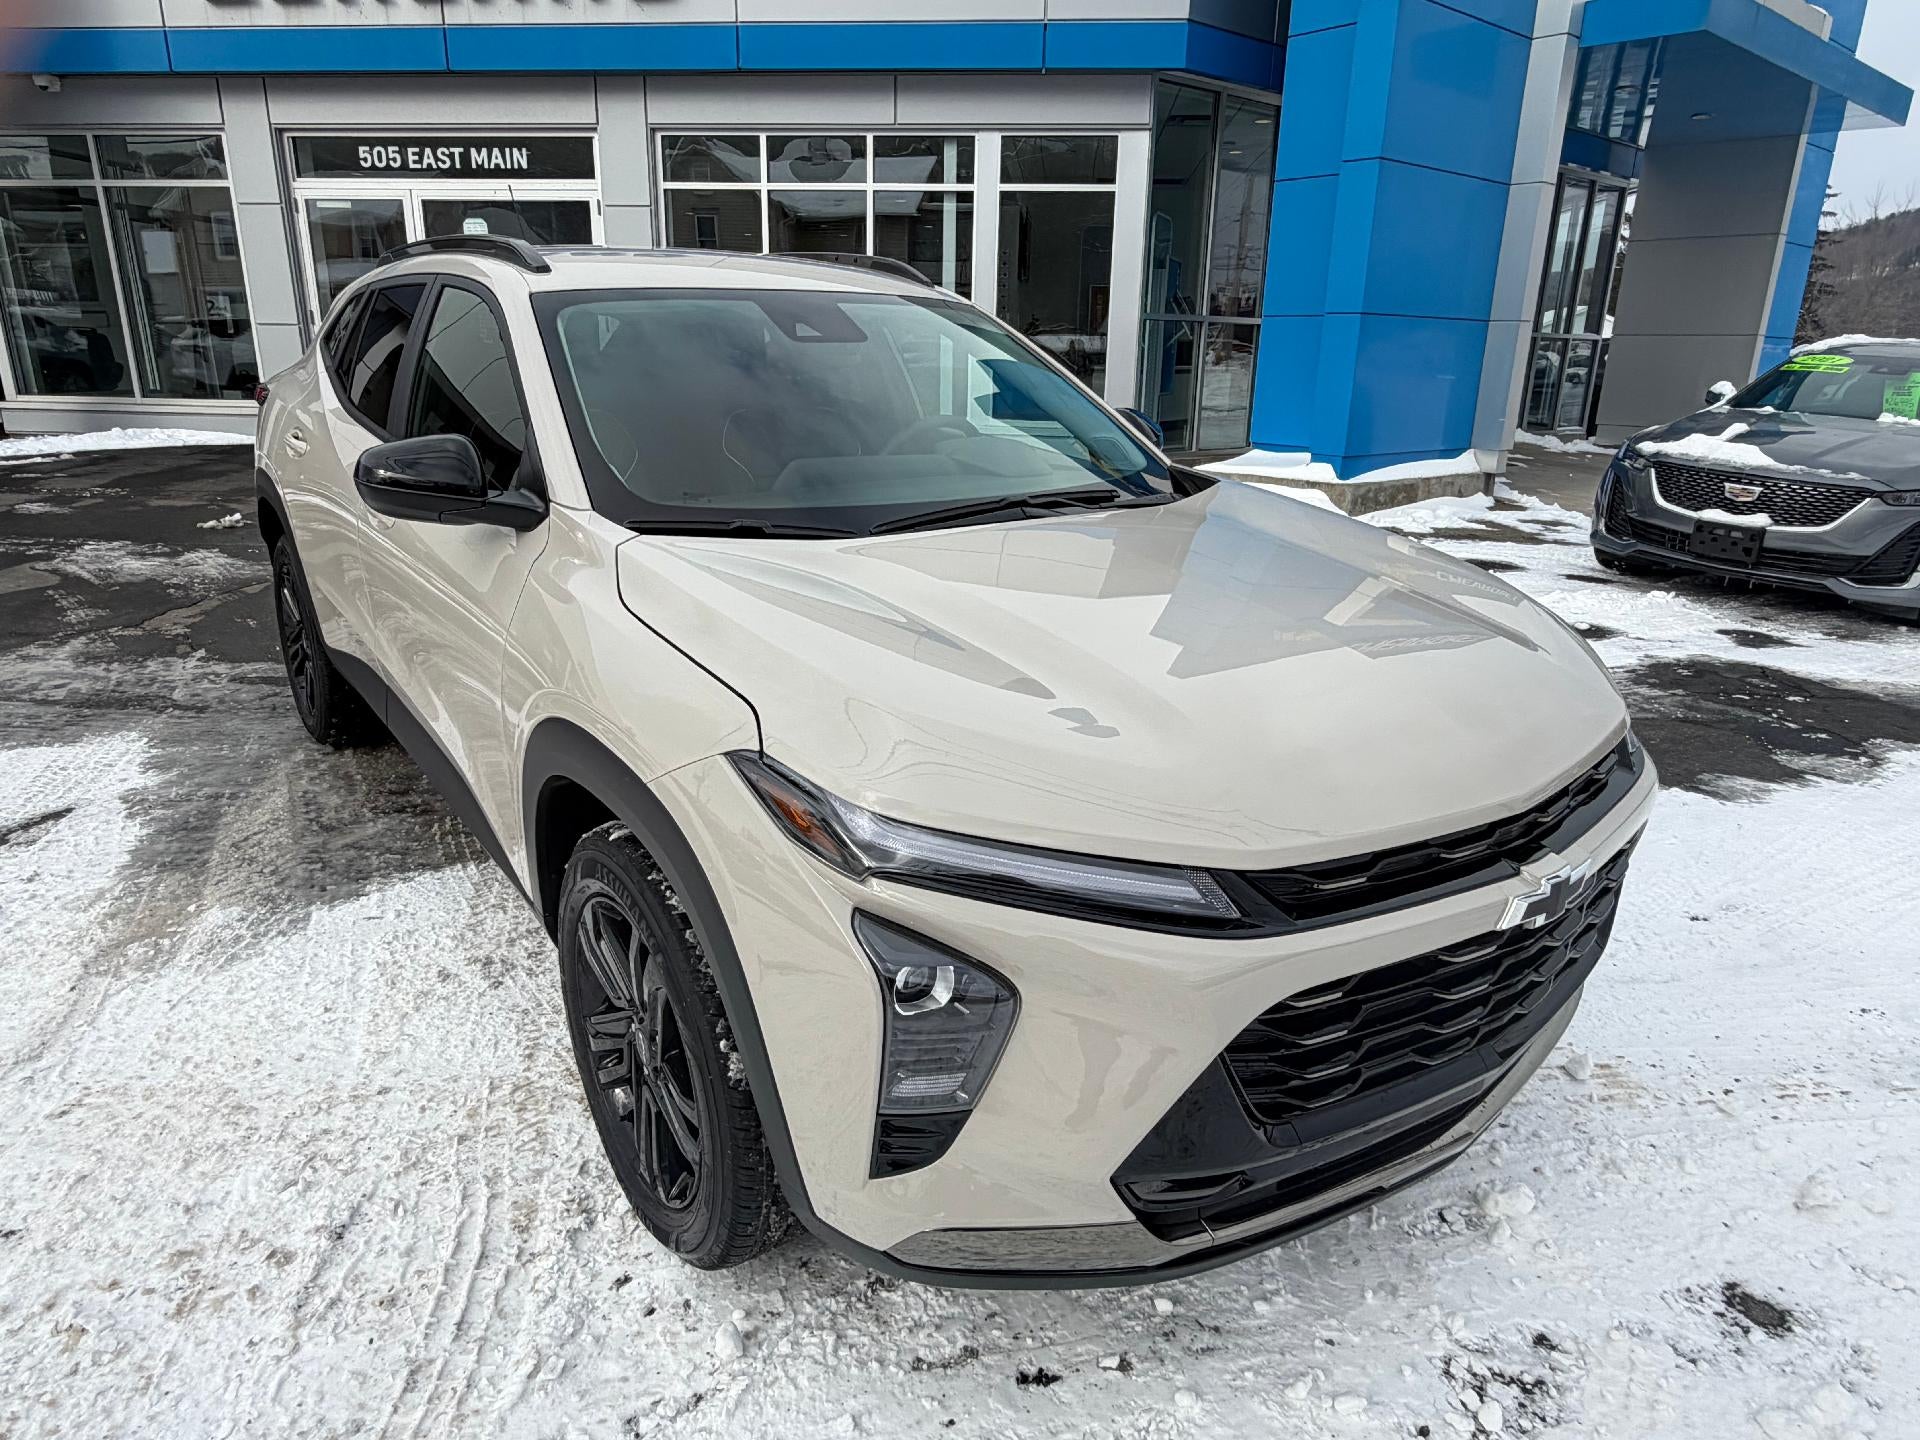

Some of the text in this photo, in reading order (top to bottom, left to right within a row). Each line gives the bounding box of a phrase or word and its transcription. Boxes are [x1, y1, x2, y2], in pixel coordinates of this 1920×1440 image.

[358, 146, 528, 169] 505 EAST MAIN
